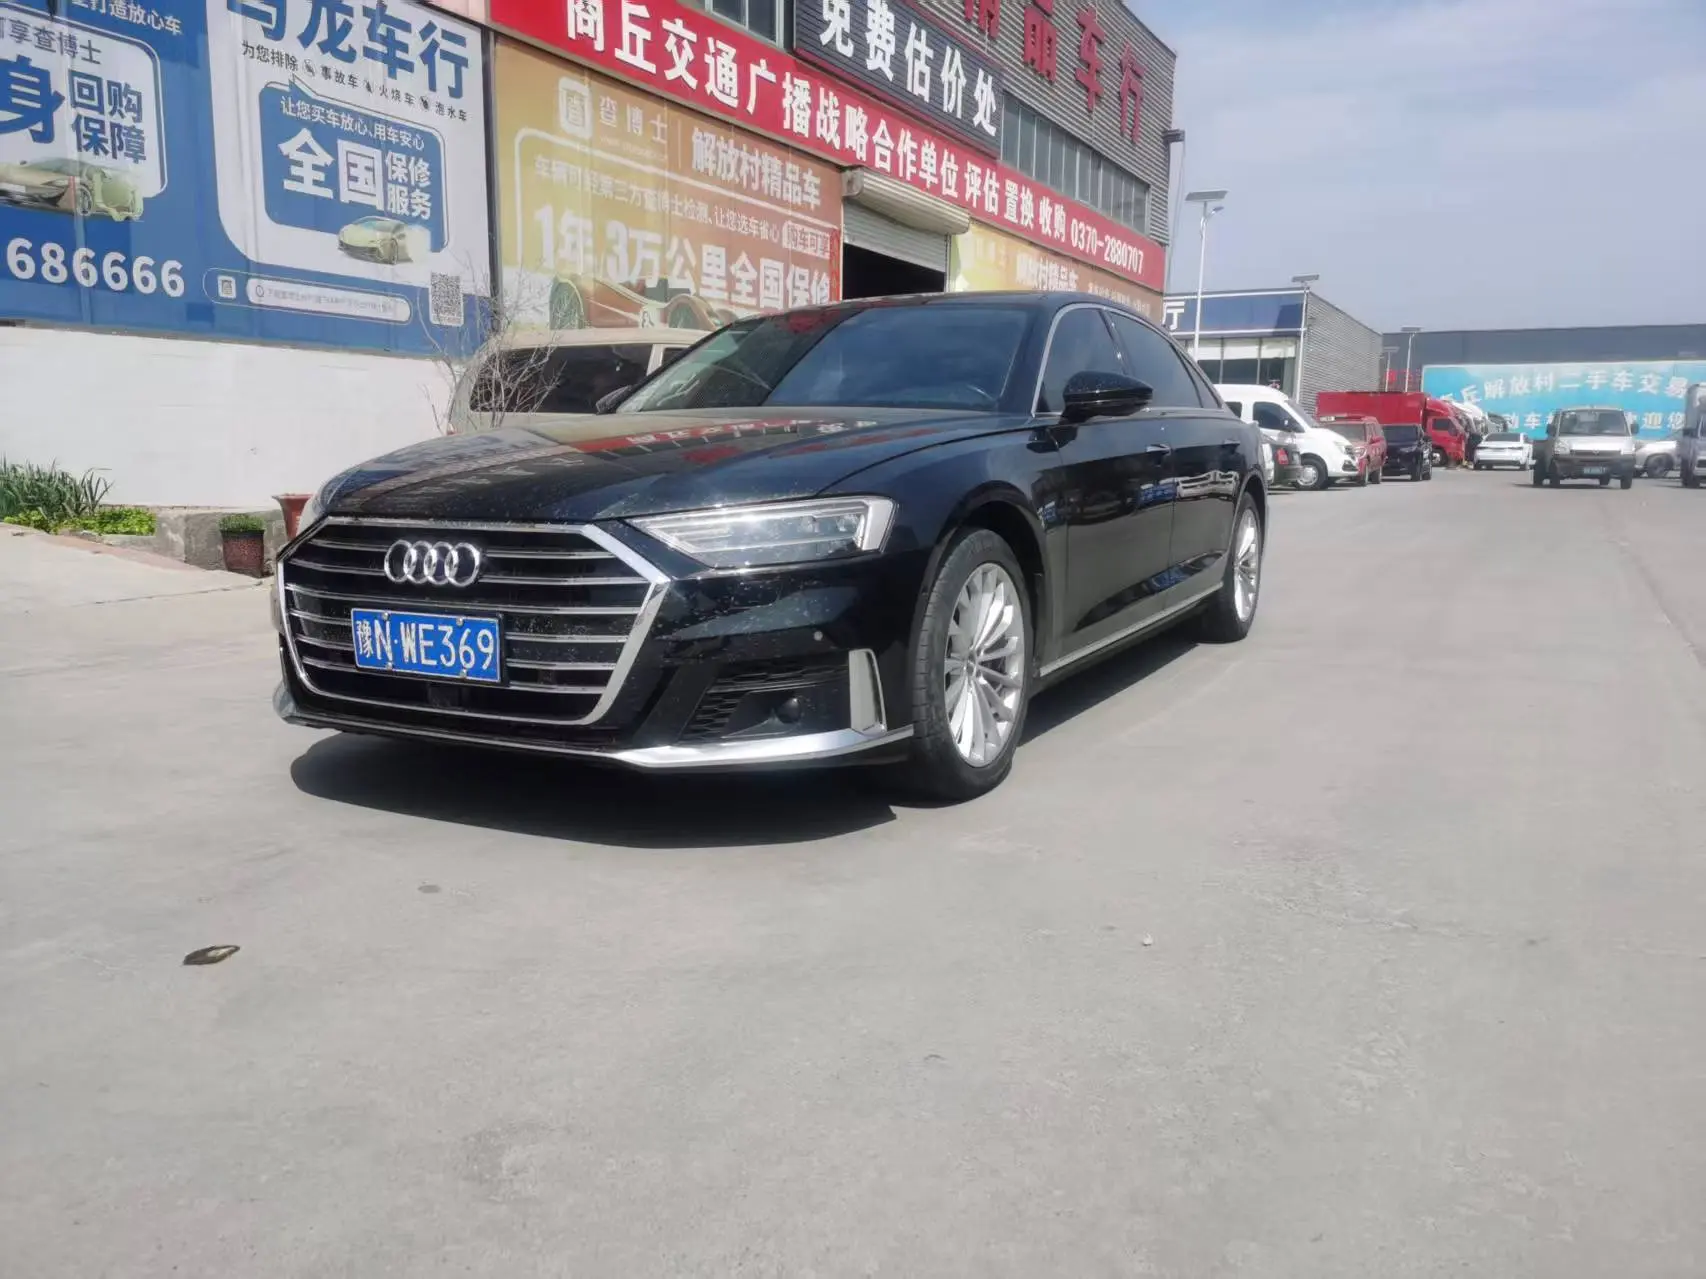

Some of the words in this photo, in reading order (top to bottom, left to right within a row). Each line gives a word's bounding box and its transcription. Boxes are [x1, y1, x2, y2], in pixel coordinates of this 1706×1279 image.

[242, 40, 299, 71] 为您排除
[320, 65, 359, 88] 事故车
[379, 83, 415, 105] 火烧车
[820, 0, 997, 136] 免费估价处
[69, 69, 143, 124] 回购
[280, 96, 424, 150] 让您买车放心、用车安心
[71, 113, 147, 164] 保障
[567, 0, 958, 198] 商丘交通广播战略合作单位
[964, 161, 1000, 215] 评估
[1004, 179, 1034, 230] 置换
[1039, 196, 1066, 242] 收购
[1071, 219, 1144, 274] 0370-2880707
[277, 127, 384, 211] 全国
[385, 151, 431, 188] 保修
[692, 127, 821, 211] 解放村精品车
[387, 183, 432, 220] 服务
[6, 237, 185, 298] 686666
[1440, 368, 1706, 404] 丘解放村二手车交易
[356, 619, 494, 671] 豫N·WE369
